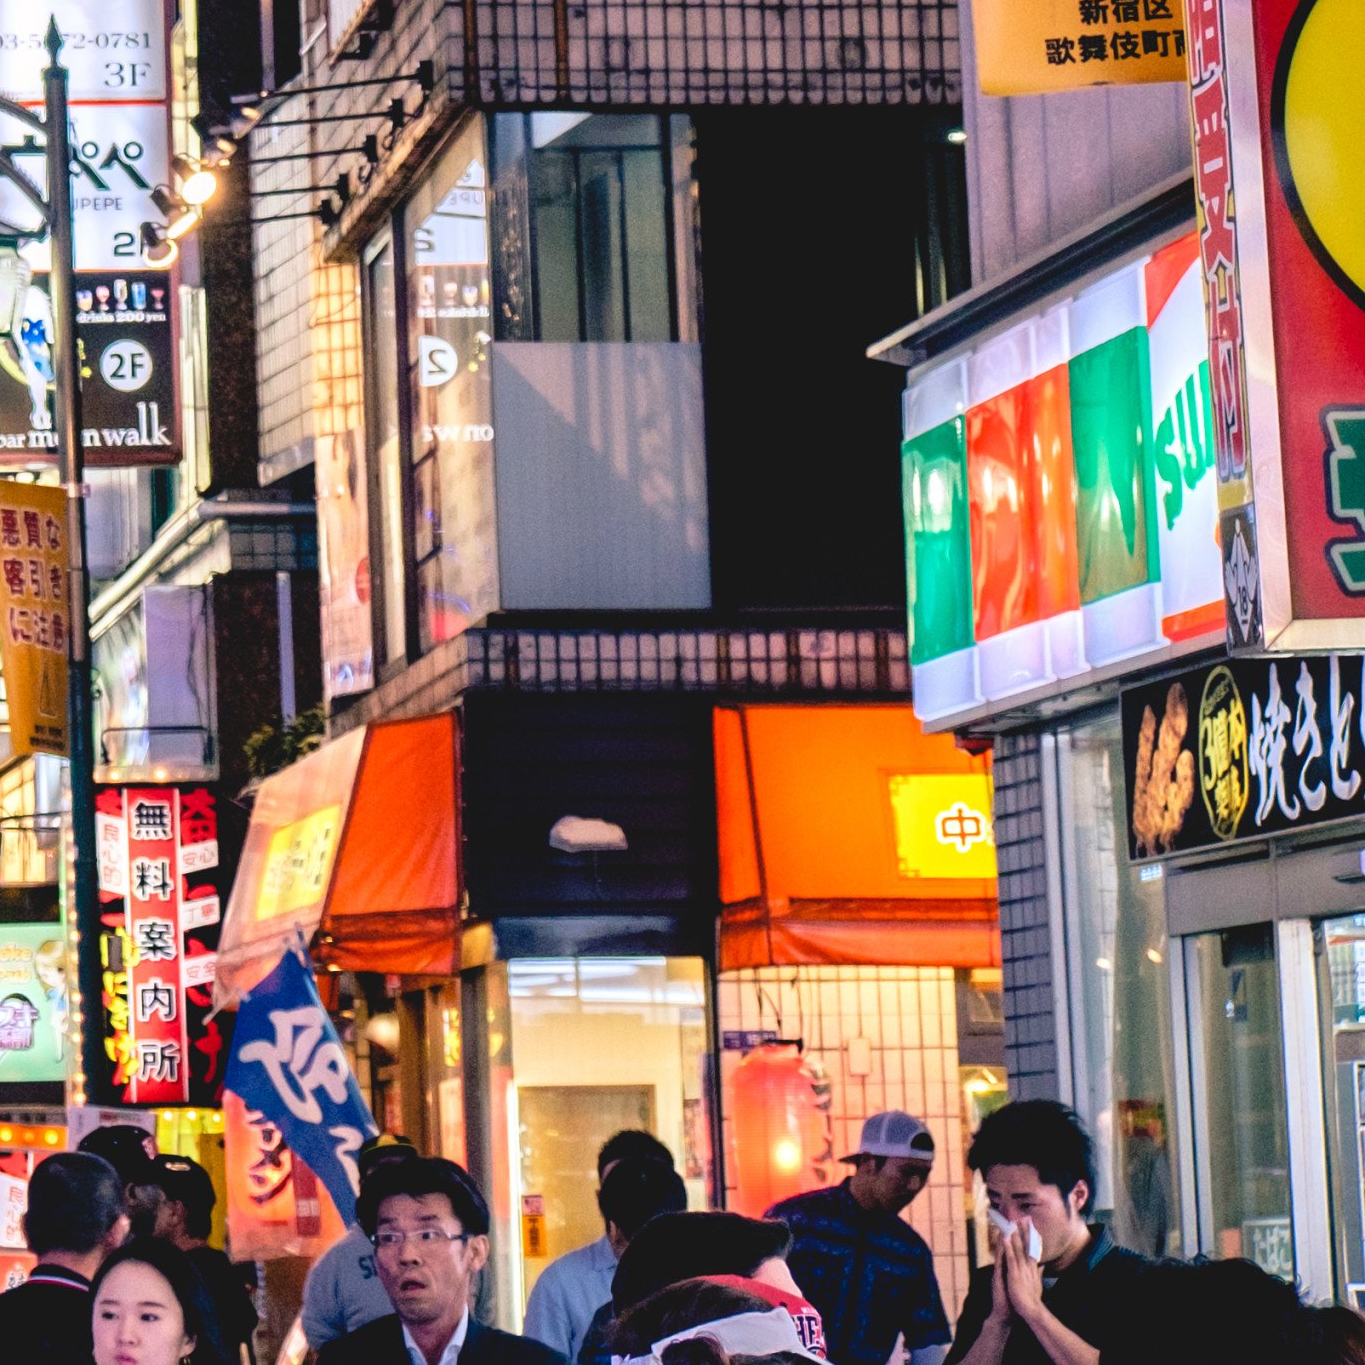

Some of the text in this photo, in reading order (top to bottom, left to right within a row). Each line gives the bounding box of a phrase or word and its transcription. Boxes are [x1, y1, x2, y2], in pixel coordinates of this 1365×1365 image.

[102, 62, 153, 88] 3F
[108, 352, 146, 379] 2F
[27, 401, 172, 451] mnwalk
[0, 508, 62, 549] 悪質な
[3, 558, 64, 601] 客引き
[1248, 653, 1365, 828] 焼きと
[934, 799, 986, 853] 中
[182, 846, 216, 869] 安心
[130, 801, 181, 1083] 無料案内所
